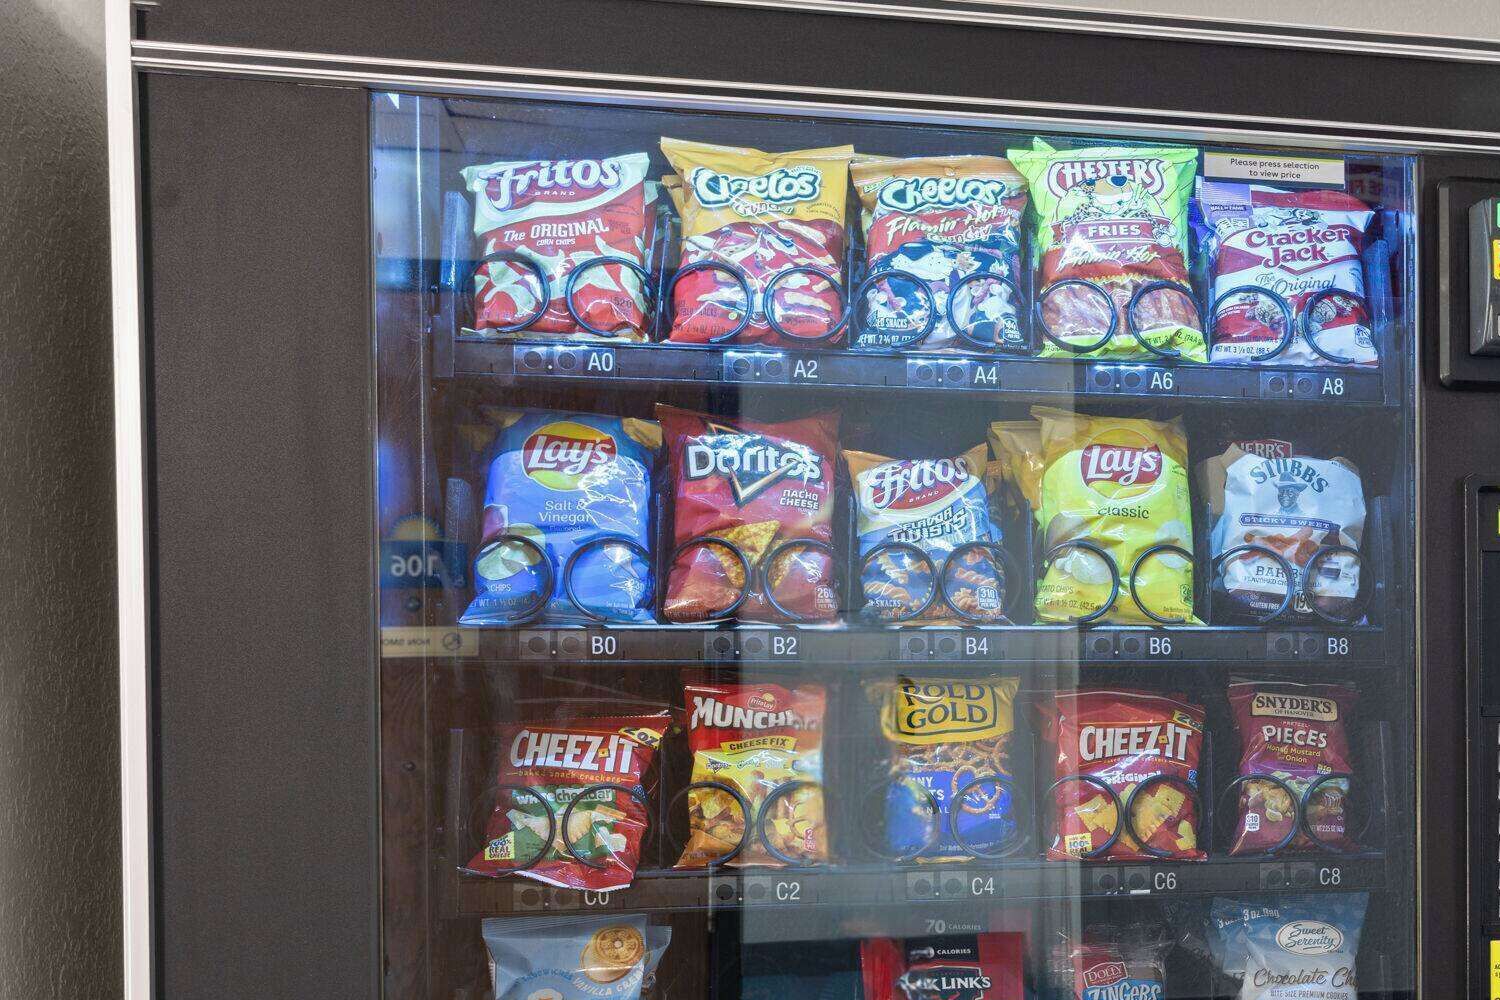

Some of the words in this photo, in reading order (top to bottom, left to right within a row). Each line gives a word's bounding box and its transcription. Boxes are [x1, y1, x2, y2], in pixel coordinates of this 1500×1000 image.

[1230, 157, 1257, 168] Please
[1259, 159, 1281, 169] press
[1283, 160, 1320, 171] selection
[1048, 159, 1166, 198] CHESTER'S
[1259, 170, 1278, 179] view
[1280, 171, 1301, 180] price
[475, 159, 623, 211] Fritos
[879, 178, 1007, 210] Cheetos
[504, 231, 526, 242] The
[531, 217, 609, 239] ORIGINAL
[1088, 224, 1141, 238] FRIES
[1246, 227, 1349, 248] Cracker
[536, 238, 554, 247] CORN
[555, 238, 576, 246] CHIPS
[1262, 246, 1328, 268] Jack
[1271, 275, 1336, 296] Original
[588, 352, 613, 371] A0
[794, 360, 818, 378] A2
[975, 366, 998, 384] A4
[1151, 372, 1173, 389] A6
[1322, 378, 1344, 395] A8
[527, 435, 613, 476] Lay's
[688, 445, 823, 480] Doritos
[1086, 446, 1158, 486] Lay's
[867, 458, 969, 509] Fritos
[1250, 459, 1329, 493] STUBB'S
[780, 498, 819, 510] CHEESE
[783, 489, 818, 501] NACHO
[908, 490, 940, 503] BRAND
[545, 500, 573, 511] Salt
[1097, 505, 1150, 519] classic
[538, 511, 591, 524] Vinegar
[1243, 515, 1285, 526] STICKY
[1290, 517, 1331, 530] SWEET
[888, 511, 969, 543] TWISTS
[592, 636, 616, 655] B0
[774, 637, 797, 655] B2
[966, 637, 988, 655] B4
[1150, 638, 1171, 655] B6
[1328, 638, 1348, 654] B8
[902, 684, 985, 707] ROLD
[1255, 695, 1332, 714] SNYDER'S
[906, 703, 988, 729] GOLD
[729, 737, 769, 751] CHEESE
[769, 737, 788, 747] FIX
[1079, 722, 1193, 761] CHEEZ-IT
[1261, 725, 1328, 748] PIECES
[510, 729, 638, 774] CHEEZ-IT
[1266, 743, 1289, 755] Honey
[1290, 747, 1321, 757] Mustard
[1285, 753, 1307, 763] Onion
[1154, 872, 1177, 890] C6
[1319, 867, 1341, 885] C8
[776, 882, 800, 900] C2
[971, 876, 995, 895] C4
[924, 919, 946, 935] 70
[1290, 923, 1326, 938] Sweet
[1284, 934, 1336, 949] Serenity
[937, 947, 972, 956] CALORIES
[1088, 965, 1122, 982] DOLLY
[1253, 966, 1327, 987] Chocolate
[572, 977, 613, 997] VANILLA
[941, 976, 992, 990] LINK'S
[1298, 990, 1326, 999] PREMIUM
[1326, 991, 1349, 1000] COOKIES
